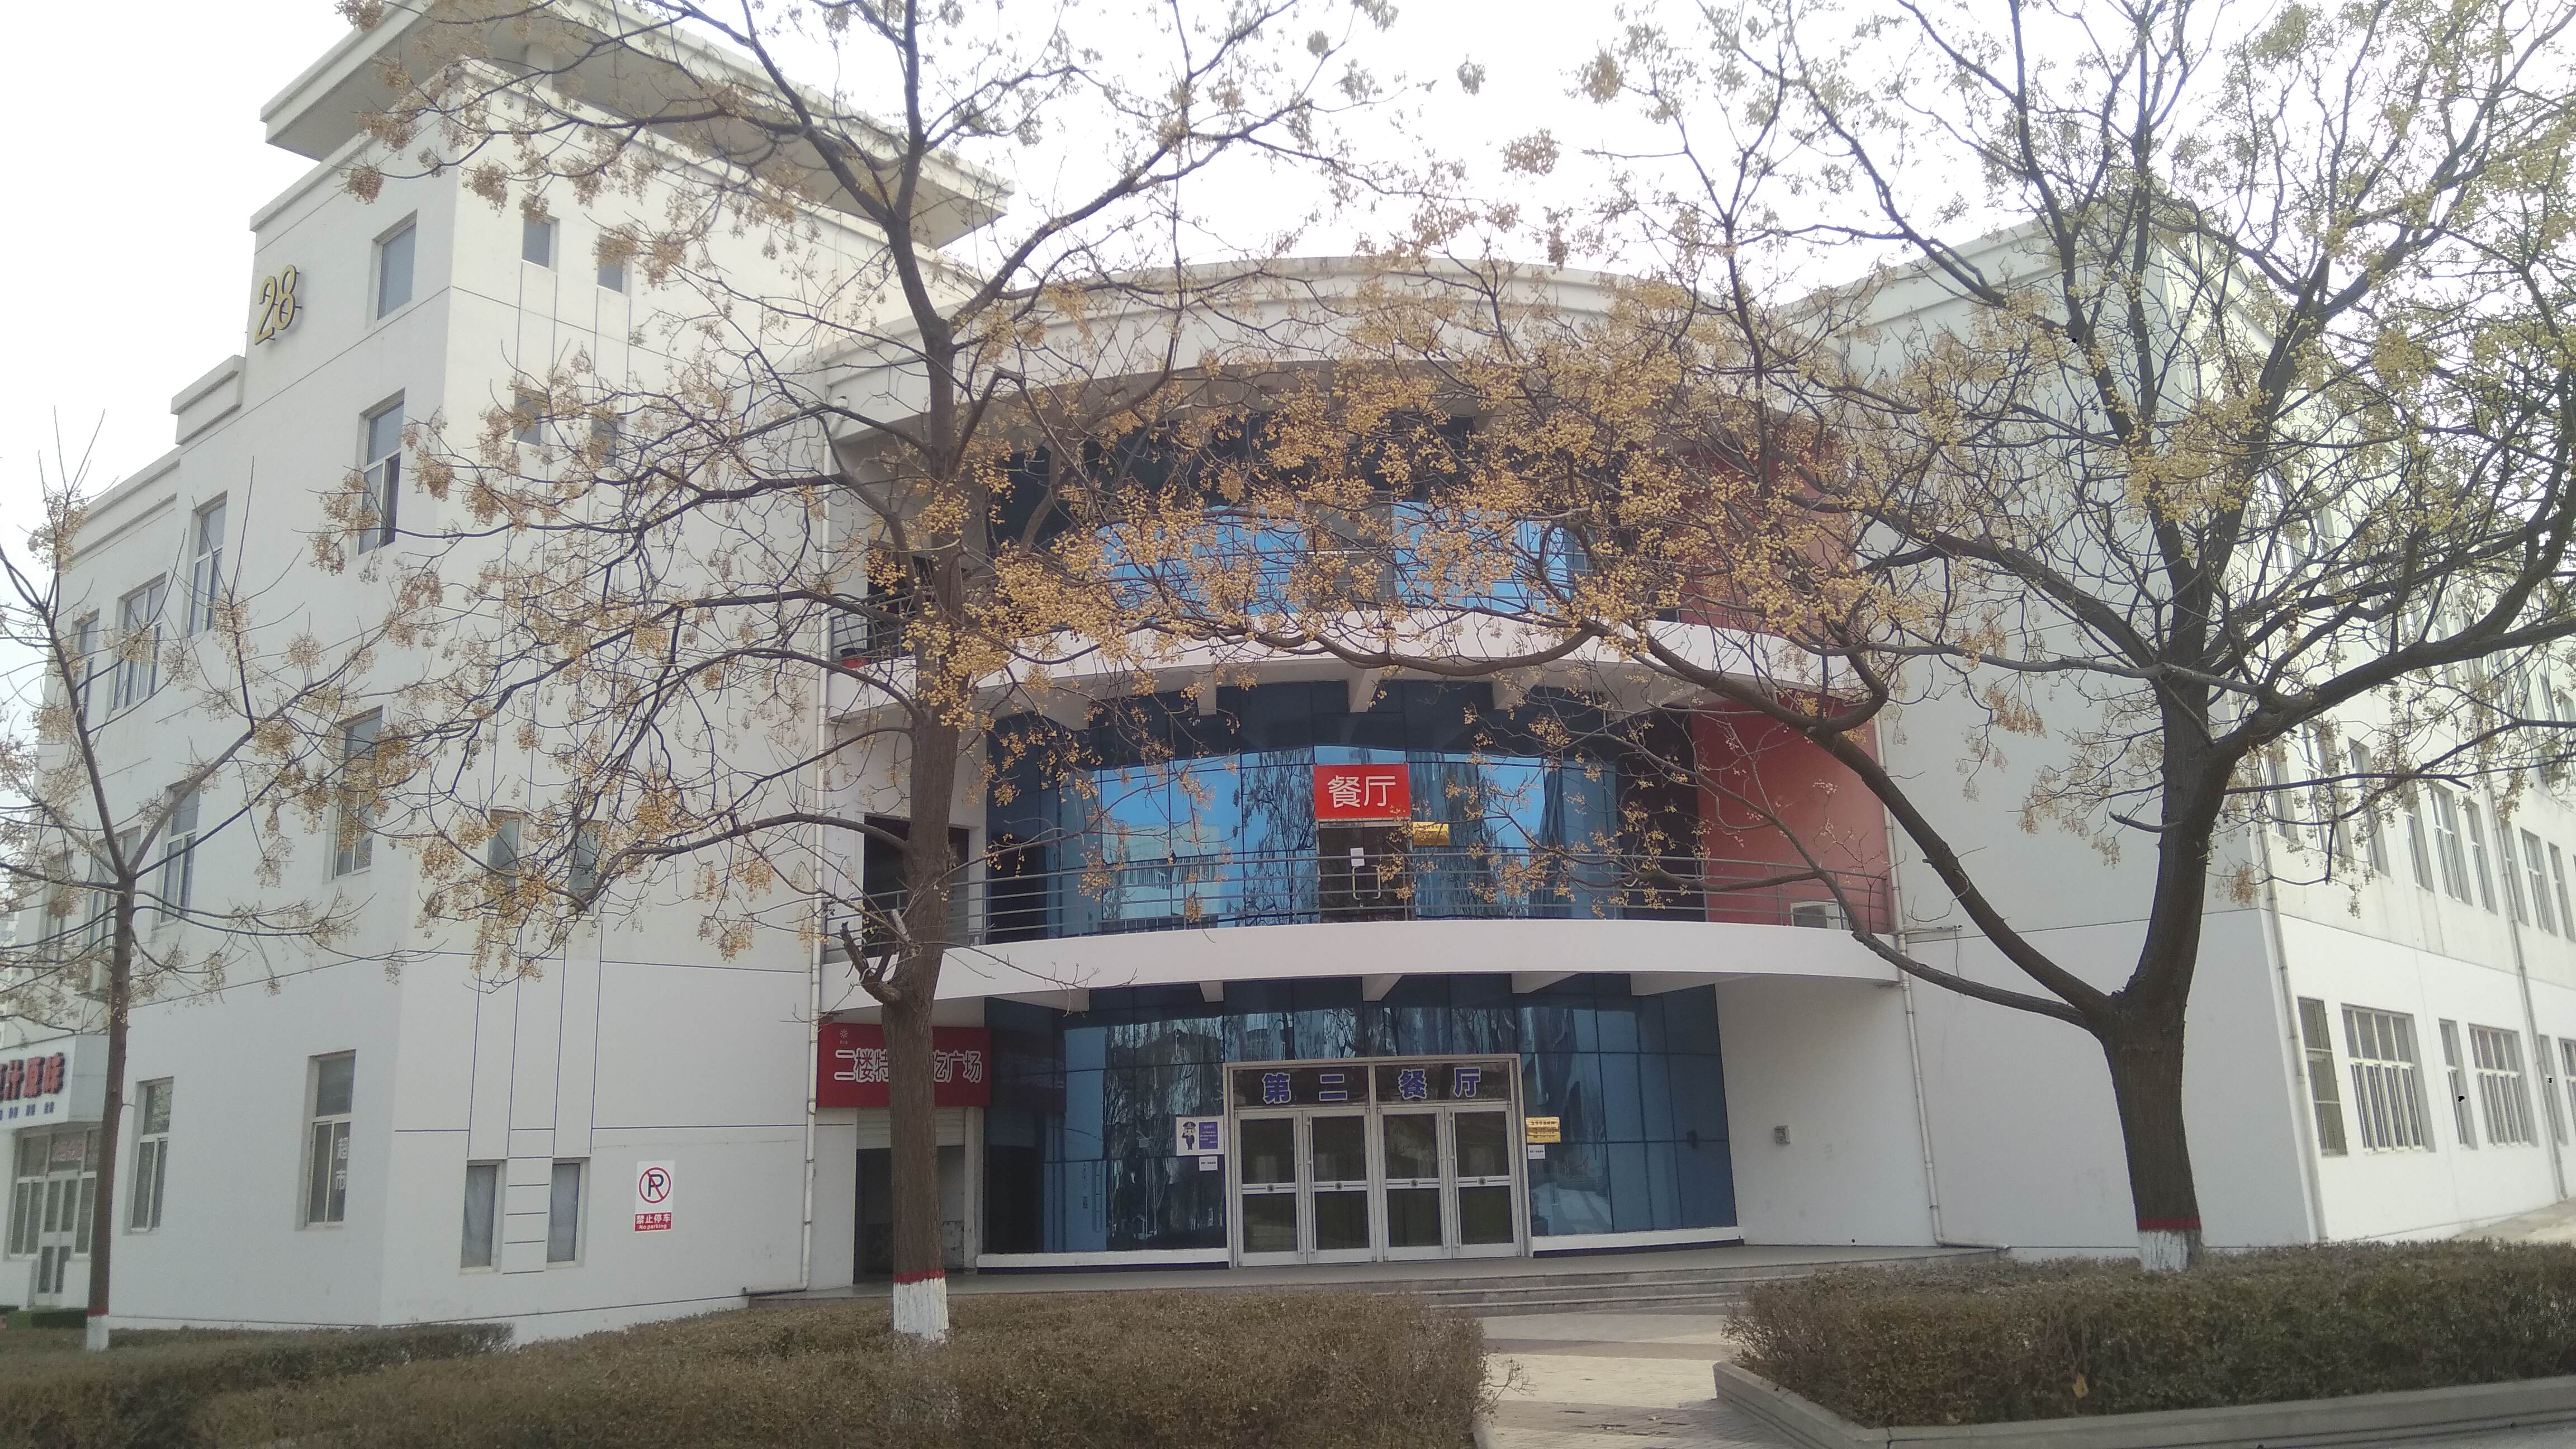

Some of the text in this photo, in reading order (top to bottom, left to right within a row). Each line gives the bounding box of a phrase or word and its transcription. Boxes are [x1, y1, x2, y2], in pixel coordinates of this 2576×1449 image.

[255, 264, 297, 345] 28
[1327, 774, 1396, 808] 餐厅
[1261, 1067, 1481, 1105] 第二餐厅
[636, 1213, 671, 1225] 禁止停车
